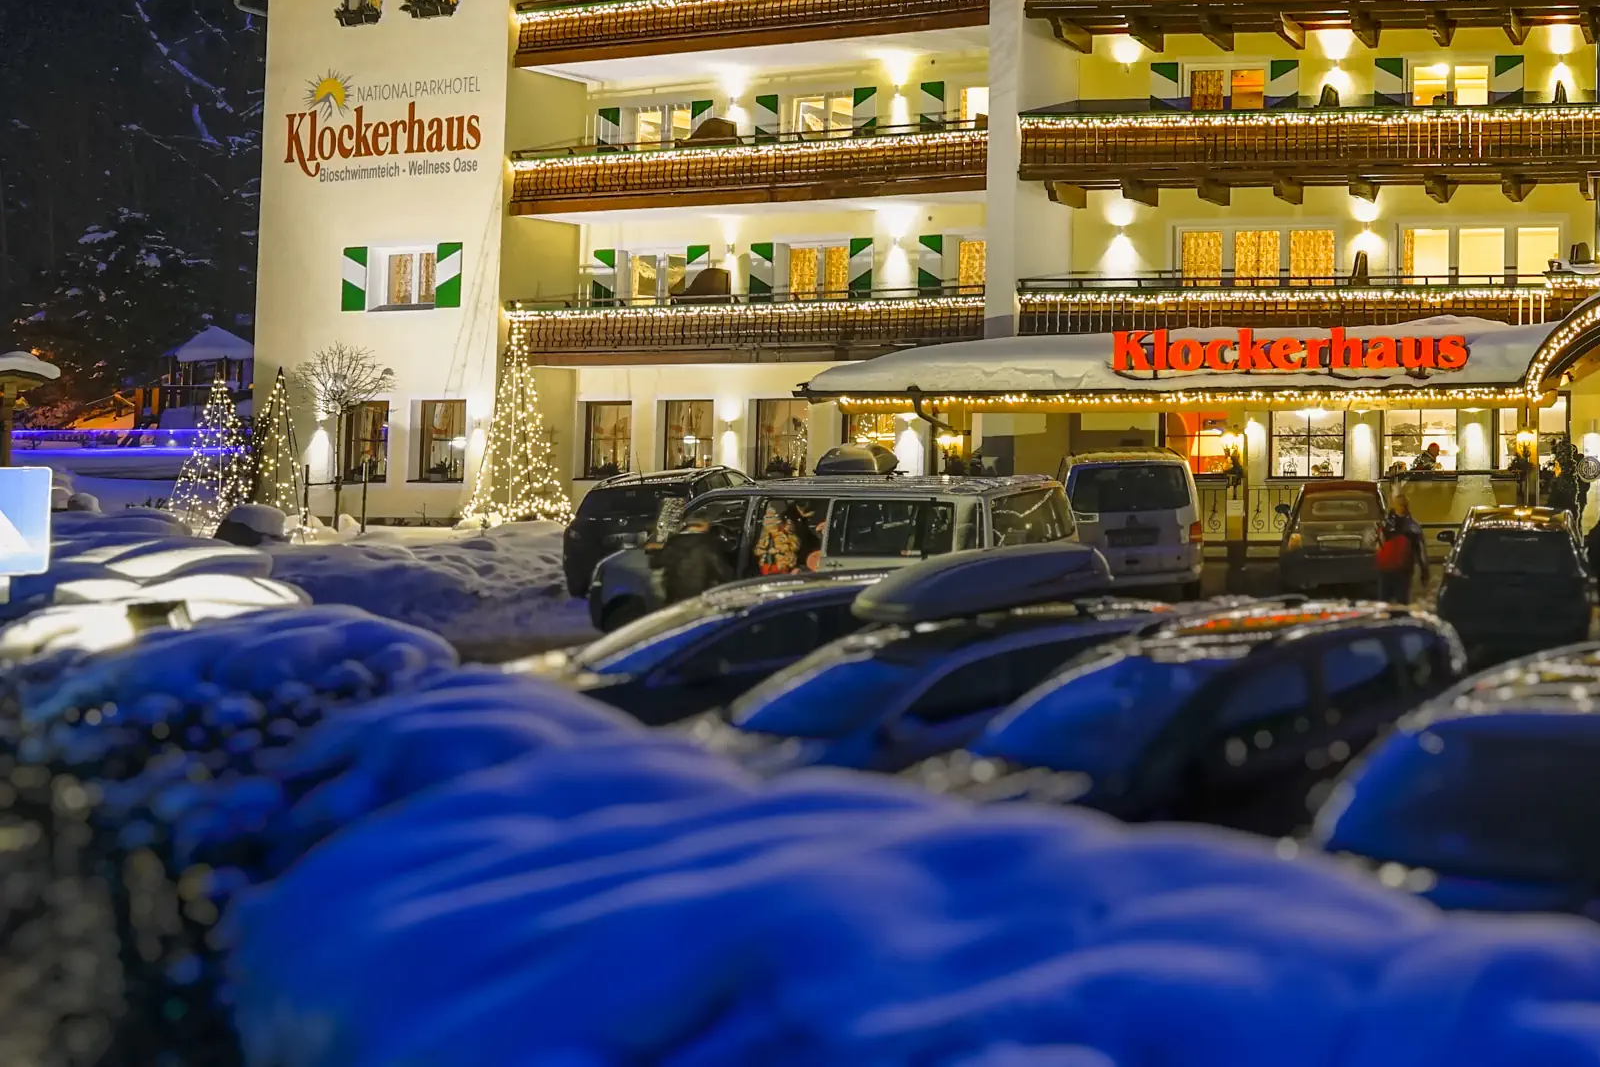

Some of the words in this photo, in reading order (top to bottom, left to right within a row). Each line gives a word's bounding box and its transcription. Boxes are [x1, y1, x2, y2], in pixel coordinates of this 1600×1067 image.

[357, 76, 481, 102] NATIONALPARKHOTEL
[284, 101, 481, 178] Klockerhaus
[319, 162, 400, 183] Bioschwimmteich
[408, 159, 451, 176] Wellness
[453, 157, 478, 173] Oase
[1112, 327, 1468, 370] Klockerhaus
